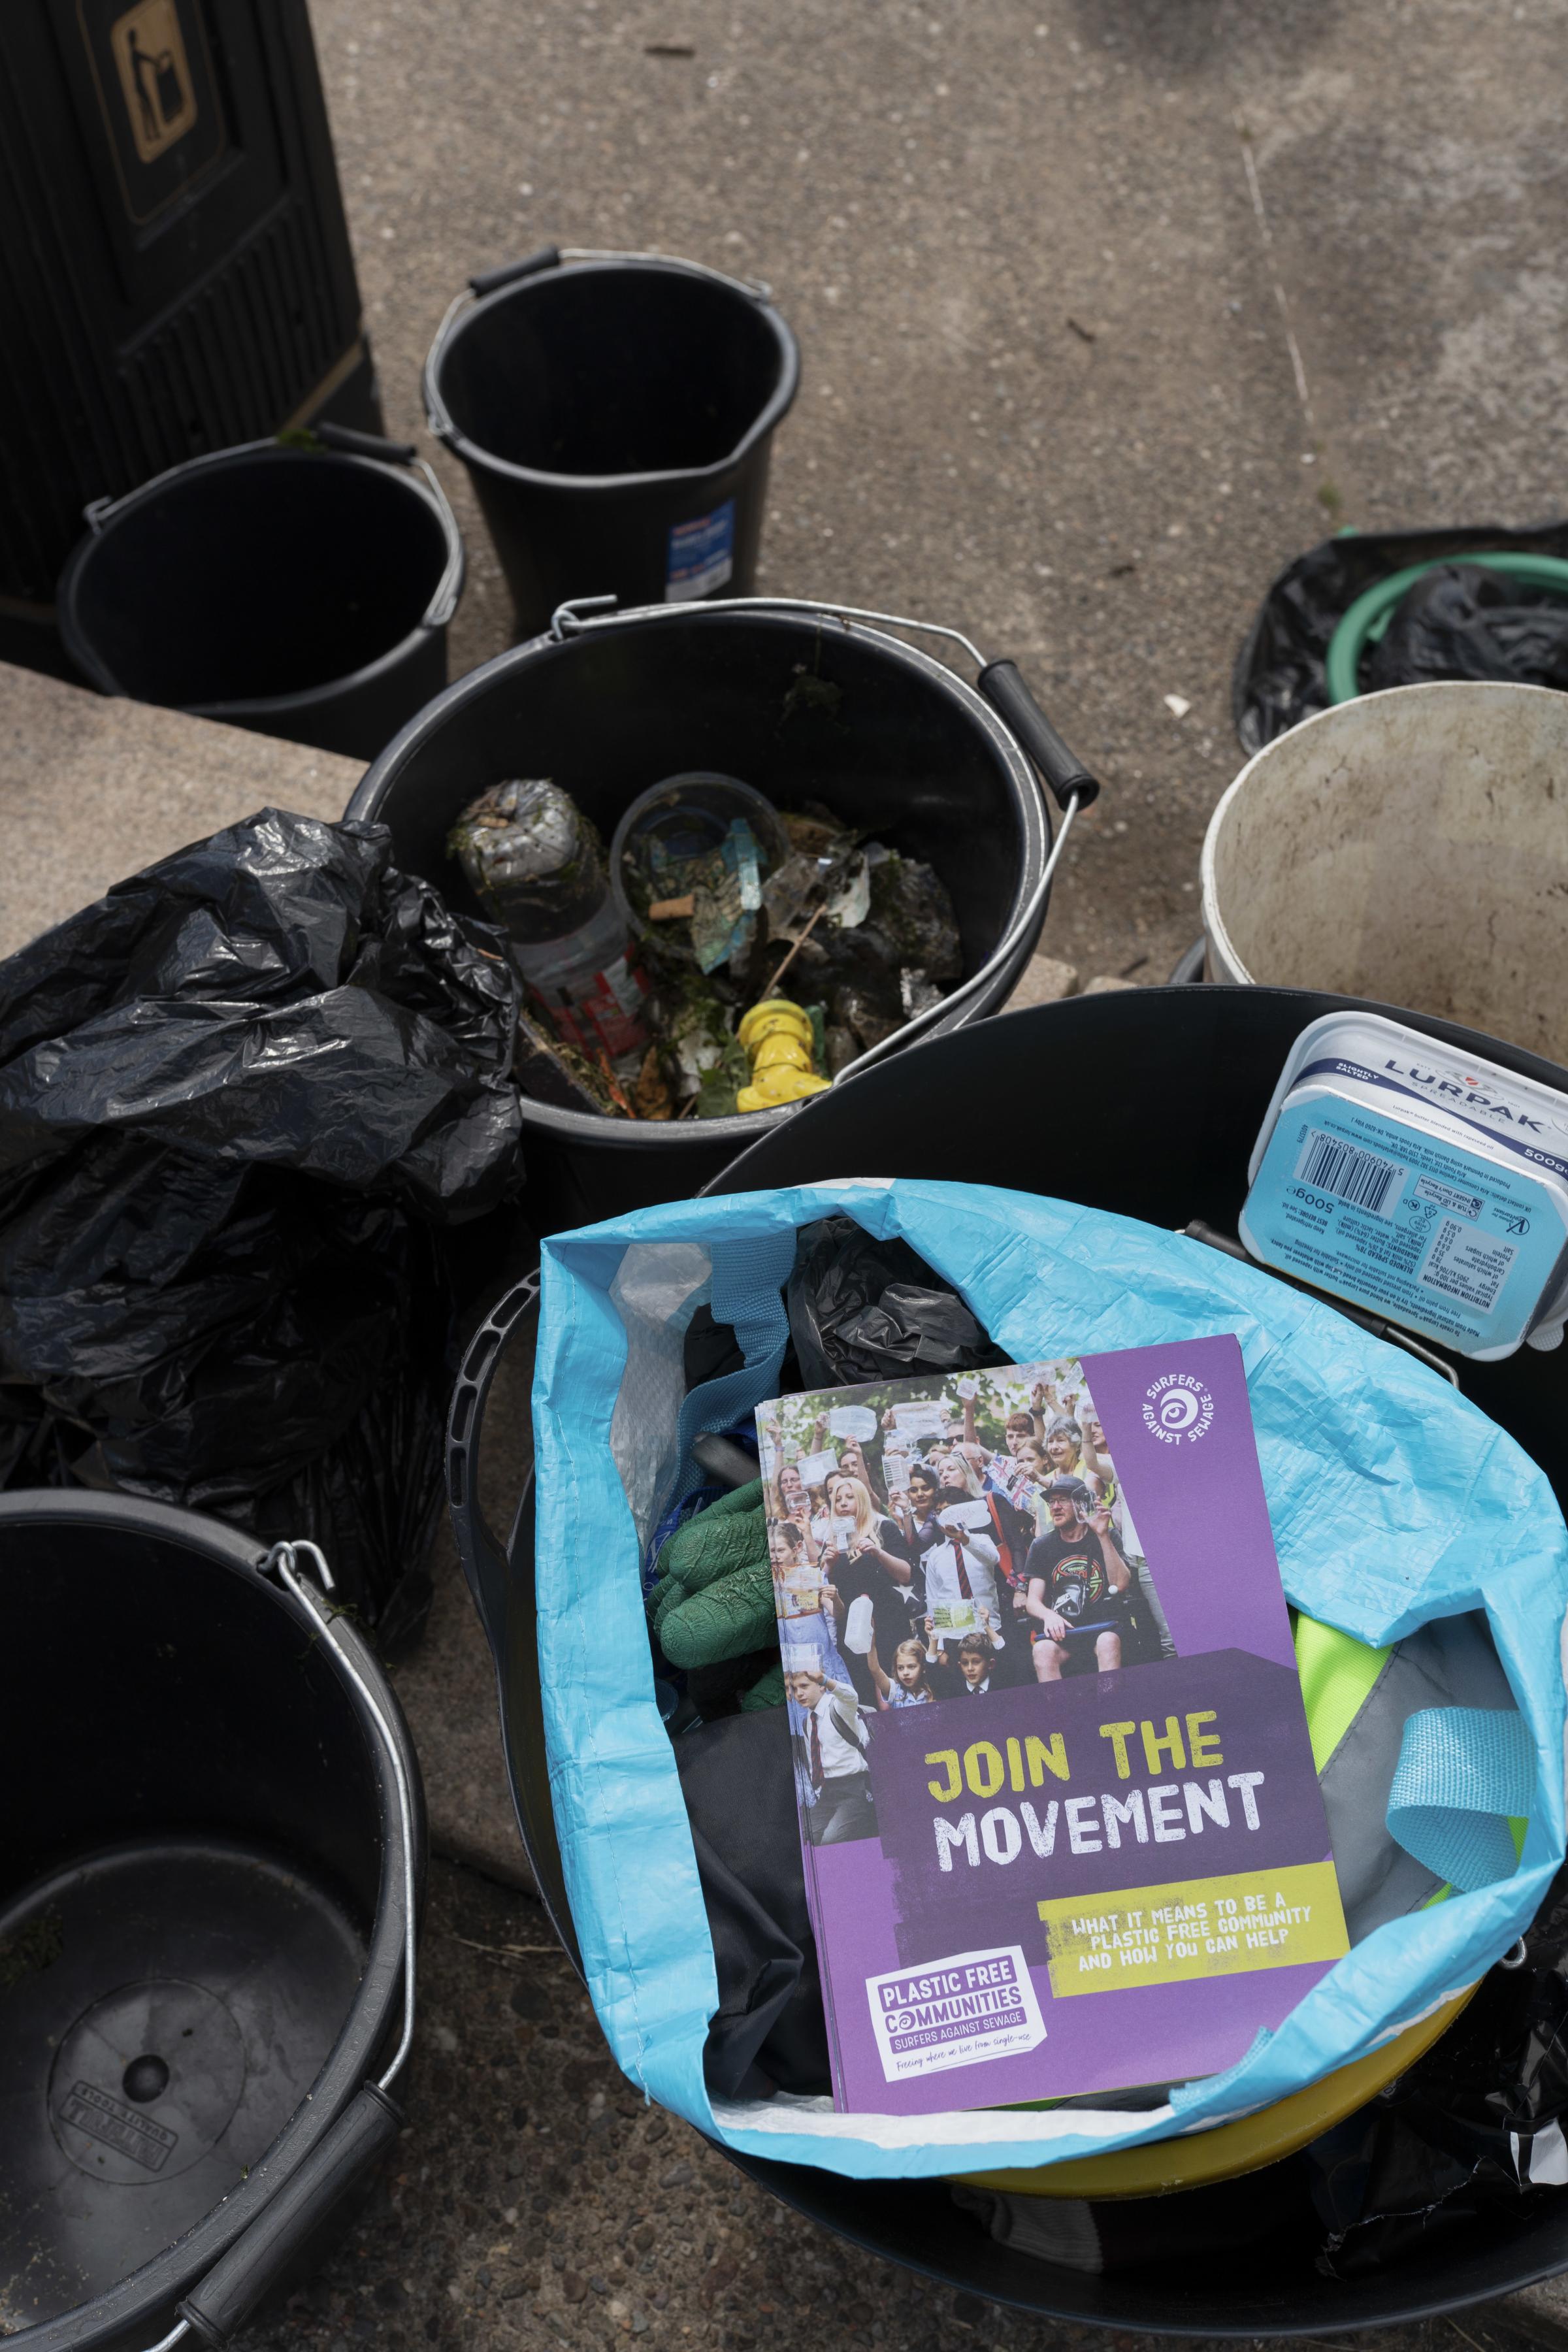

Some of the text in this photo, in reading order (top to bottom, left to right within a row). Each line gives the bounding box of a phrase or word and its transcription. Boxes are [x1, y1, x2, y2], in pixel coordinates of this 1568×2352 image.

[1335, 1063, 1368, 1080] SALTED
[1338, 1062, 1379, 1079] SLIGHTLY
[1385, 1060, 1541, 1132] LURPAK
[1412, 1081, 1504, 1122] SPREADABLE
[1319, 1133, 1404, 1176] 5 740900 805408
[1420, 1178, 1439, 1190] Recycle
[1424, 1187, 1443, 1201] Recycle
[1452, 1192, 1471, 1203] INSERT
[1288, 1205, 1298, 1213] See
[1457, 1203, 1467, 1212] TUB
[1316, 1217, 1328, 1226] BEST
[1342, 1215, 1360, 1226] culture
[1356, 1207, 1384, 1223] ingredients
[1313, 1225, 1324, 1235] Keep
[1360, 1223, 1373, 1233] lactic
[1446, 1230, 1456, 1238] 0.5
[1449, 1223, 1462, 1233] 0.90
[1345, 1232, 1367, 1245] rapeseed
[1369, 1235, 1386, 1246] Butter
[1443, 1236, 1453, 1245] 0.6
[1387, 1243, 1419, 1260] INGREDIENTS:
[1398, 1240, 1422, 1254] rapeseed
[1441, 1243, 1450, 1251] 0.6
[1465, 1245, 1482, 1256] sugars
[1503, 1246, 1514, 1256] Salt
[1355, 1243, 1413, 1274] BLENDED SPREAD 78%
[1391, 1252, 1403, 1261] milk
[1482, 1253, 1497, 1263] which
[1492, 1249, 1511, 1262] Protein
[1428, 1260, 1439, 1270] kcal
[1453, 1256, 1476, 1269] saturates
[1471, 1256, 1505, 1275] Carbohydrate
[1439, 1273, 1448, 1282] 100
[1476, 1266, 1492, 1276] which
[1456, 1273, 1469, 1283] 2905
[1490, 1280, 1499, 1288] Fat
[1422, 1274, 1490, 1308] NUTRITION INFORMATION
[1459, 1281, 1475, 1292] values
[1478, 1282, 1496, 1295] Energy
[1475, 1289, 1493, 1301] Typical
[1147, 1374, 1203, 1399] SURFERS
[1142, 1394, 1214, 1445] AGAINST SEWAGE
[924, 1710, 1224, 1803] JOIN THE
[933, 1771, 1265, 1872] MOVEMENT
[1071, 1892, 1286, 1935] WHAT IT MEANS TO BE A
[1090, 1906, 1312, 1951] PLASTIC FREE COMMUNITY
[1079, 1929, 1289, 1972] AND HOW YOU CAN HELP
[883, 1960, 1013, 2008] PLASTIC FREE
[885, 1985, 1022, 2034] COMMUNITIES
[894, 2011, 1022, 2050] SURFERS AGAINST SEWAGE
[896, 2032, 1032, 2072] Freeing where we live from single-use
